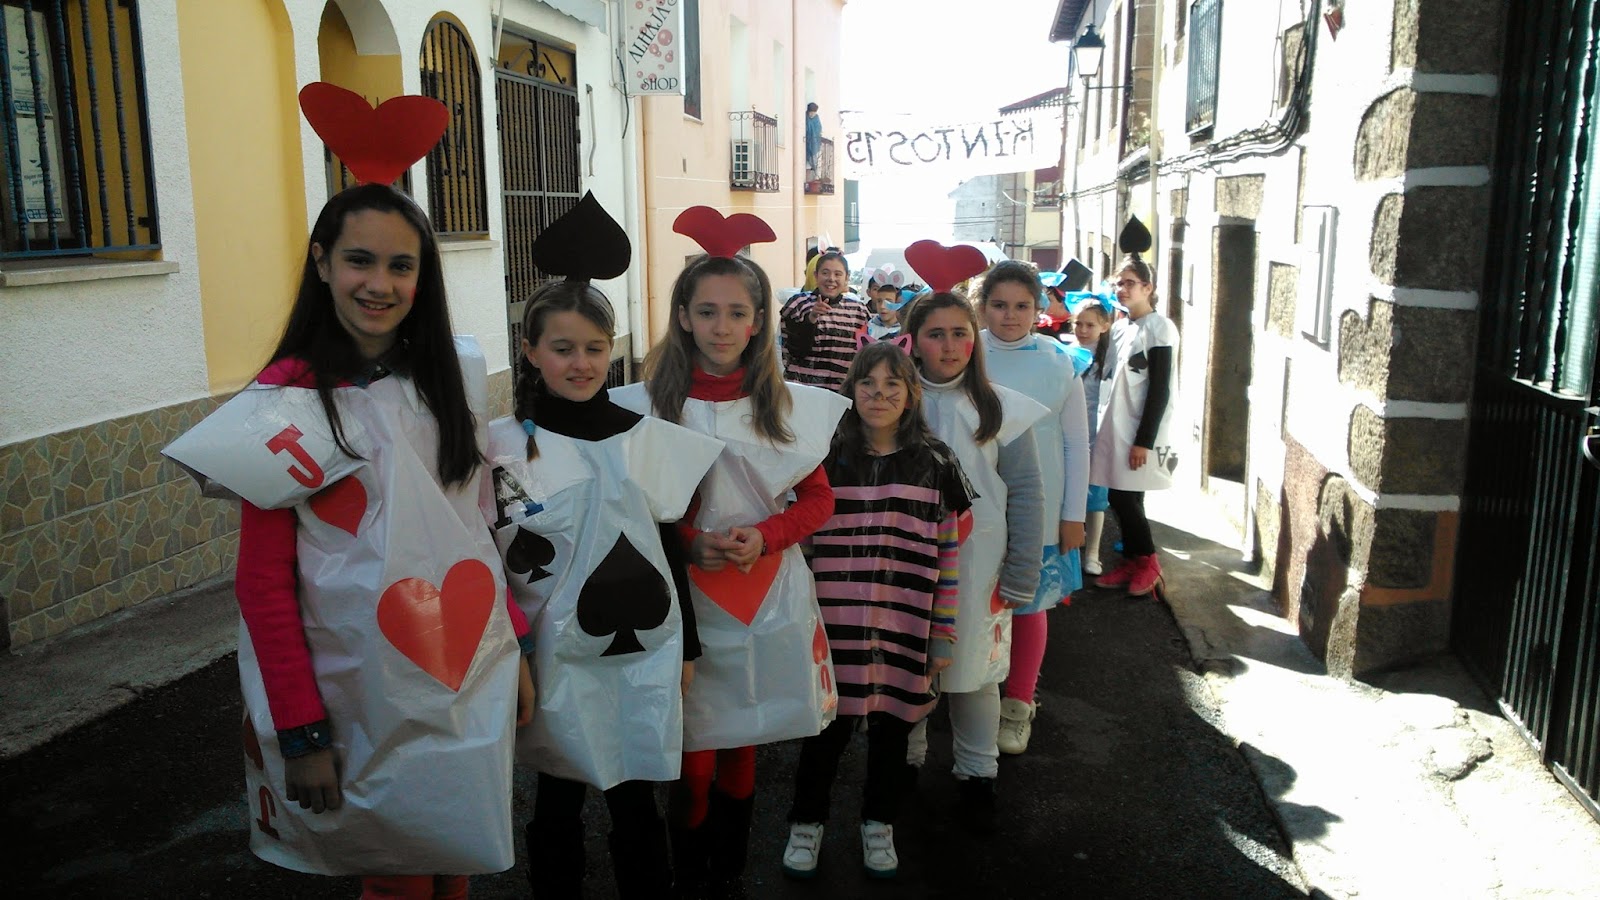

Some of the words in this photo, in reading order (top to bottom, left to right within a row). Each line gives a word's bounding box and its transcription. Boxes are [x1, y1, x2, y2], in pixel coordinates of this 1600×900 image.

[642, 77, 678, 91] SHOP
[265, 423, 325, 489] J
[1155, 445, 1171, 467] A
[492, 465, 545, 530] A
